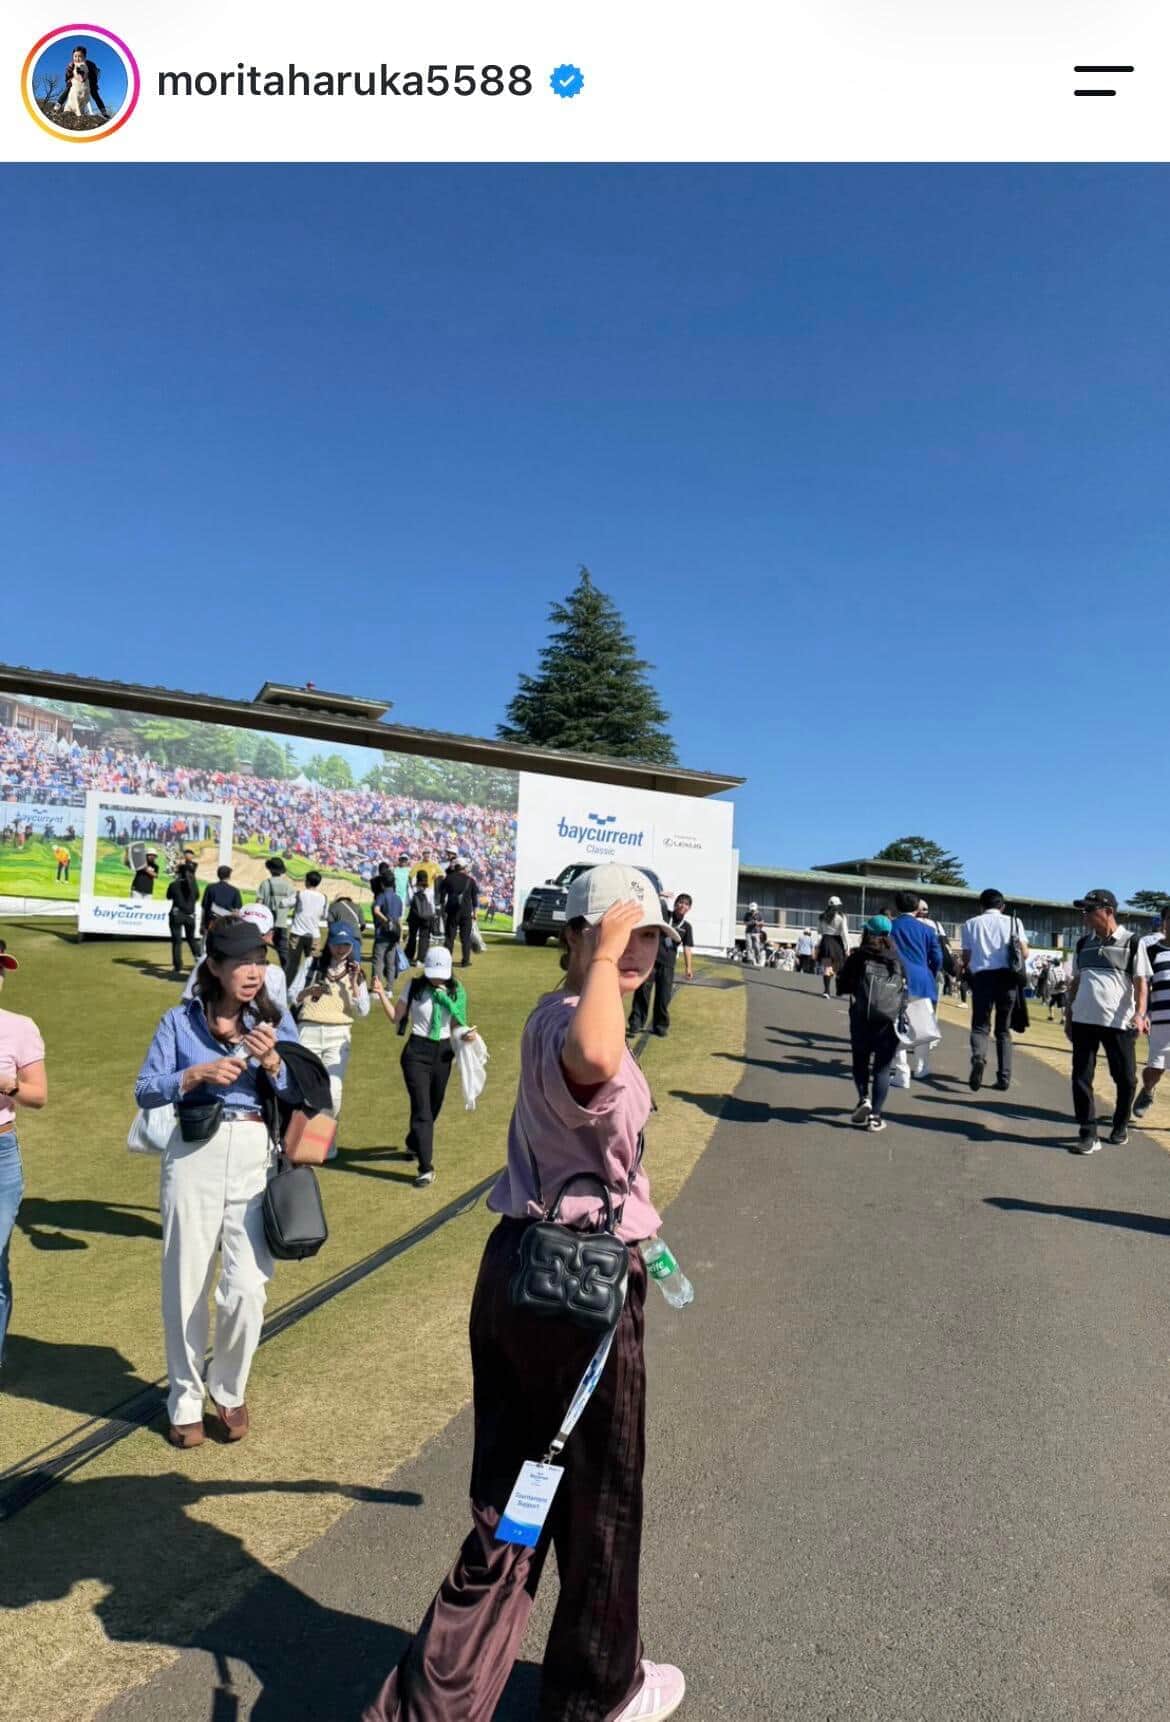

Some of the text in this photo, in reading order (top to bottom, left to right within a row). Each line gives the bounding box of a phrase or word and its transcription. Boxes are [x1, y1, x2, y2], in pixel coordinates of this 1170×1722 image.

[557, 816, 644, 847] baycurrent
[586, 844, 616, 856] Classic
[93, 906, 167, 921] baycurrent
